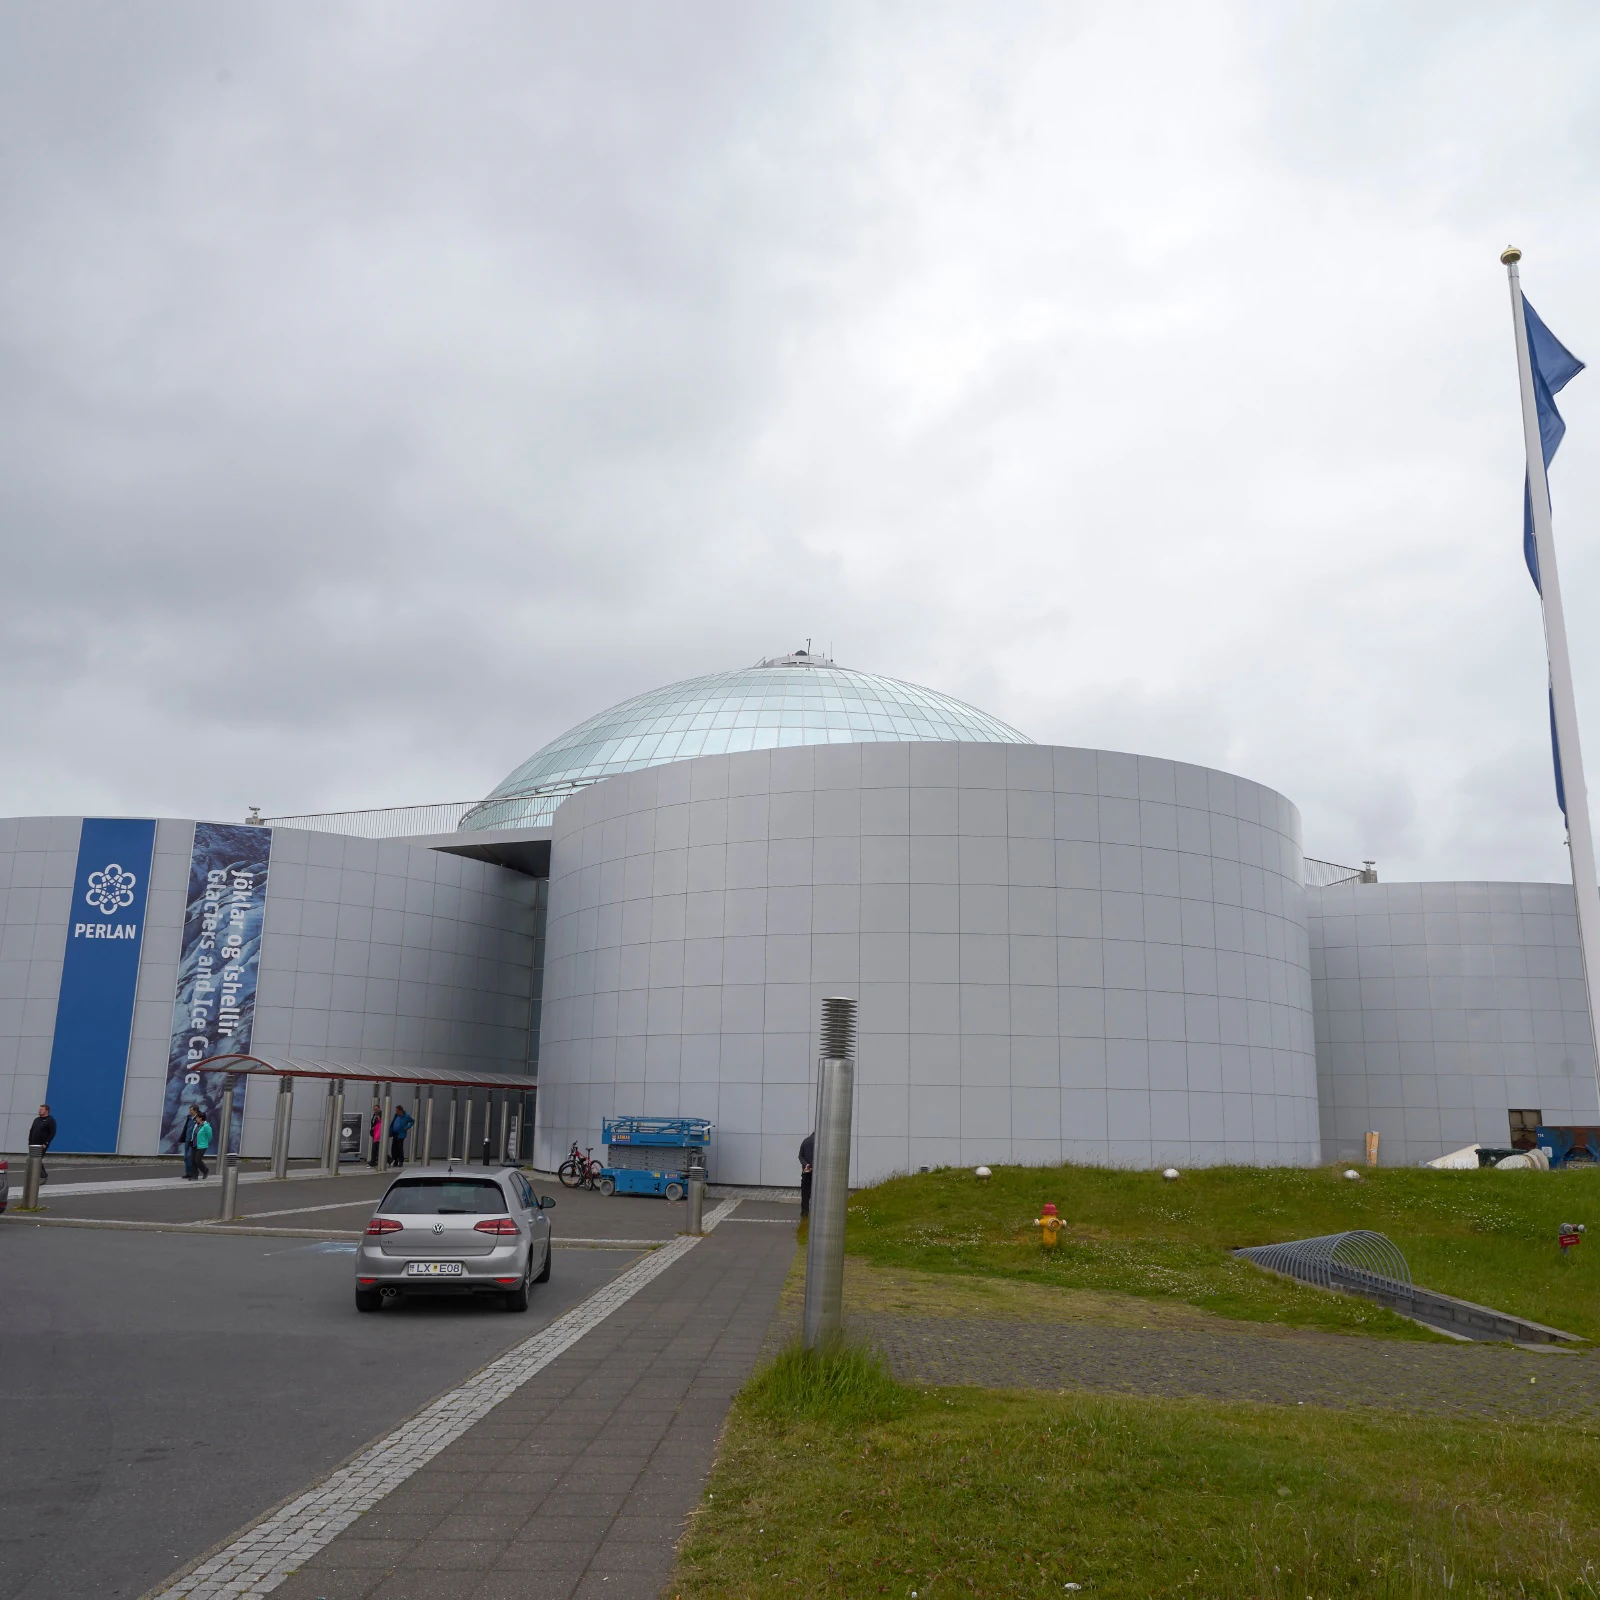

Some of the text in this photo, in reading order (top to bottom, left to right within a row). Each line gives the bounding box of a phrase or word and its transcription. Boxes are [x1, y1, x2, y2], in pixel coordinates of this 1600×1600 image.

[200, 869, 228, 949] Glaciers
[74, 923, 137, 939] PERLAN
[217, 869, 254, 1037] Jöklar og íshellir
[195, 955, 215, 992] and
[191, 998, 213, 1029] Ice
[417, 1264, 460, 1272] LX E08
